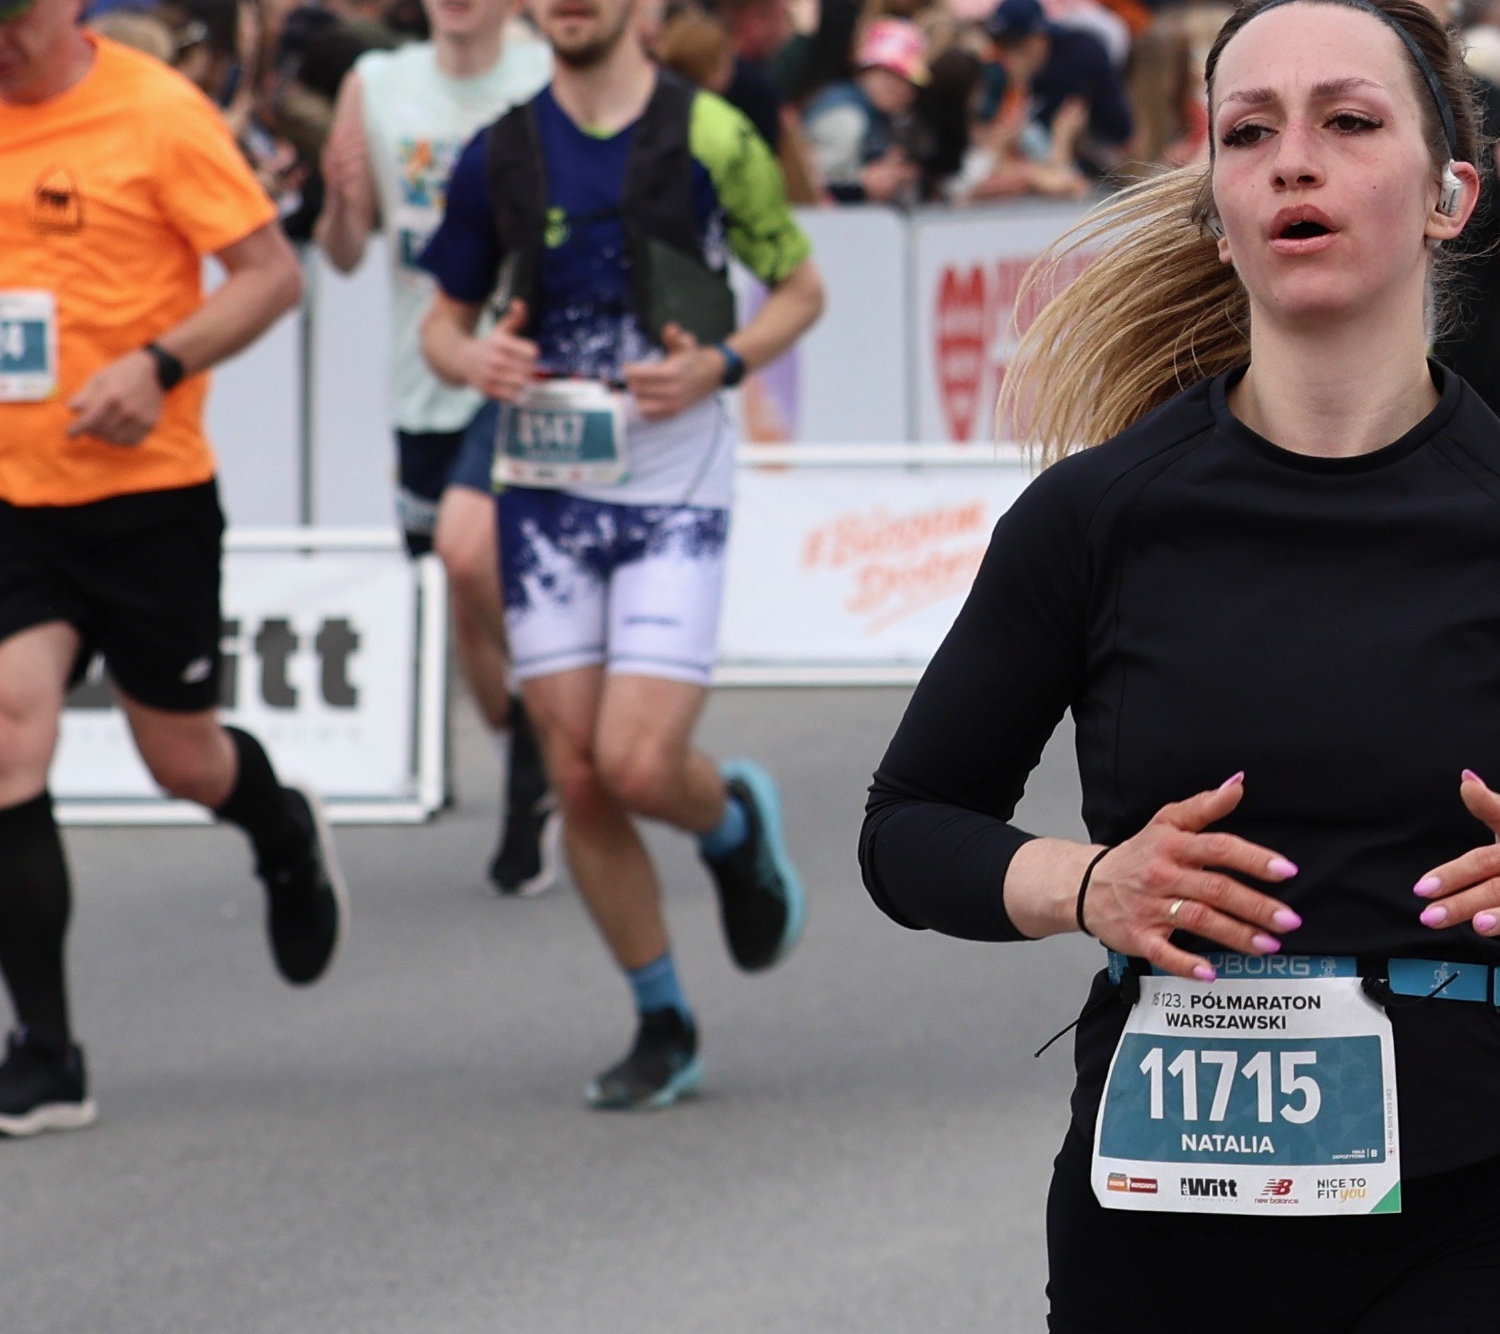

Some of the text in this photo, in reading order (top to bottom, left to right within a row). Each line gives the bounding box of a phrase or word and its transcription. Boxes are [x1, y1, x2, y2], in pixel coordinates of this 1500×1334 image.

[1206, 953, 1311, 976] YBORG
[1190, 991, 1321, 1011] PÓŁMARATON
[1166, 1012, 1286, 1030] WARSZAWSKI
[1139, 1047, 1322, 1124] 11715
[1181, 1133, 1275, 1154] NATALIA
[1188, 1177, 1238, 1198] Witt
[1316, 1178, 1367, 1189] NICE TO
[1269, 1197, 1299, 1205] balance
[1317, 1189, 1339, 1200] FIT
